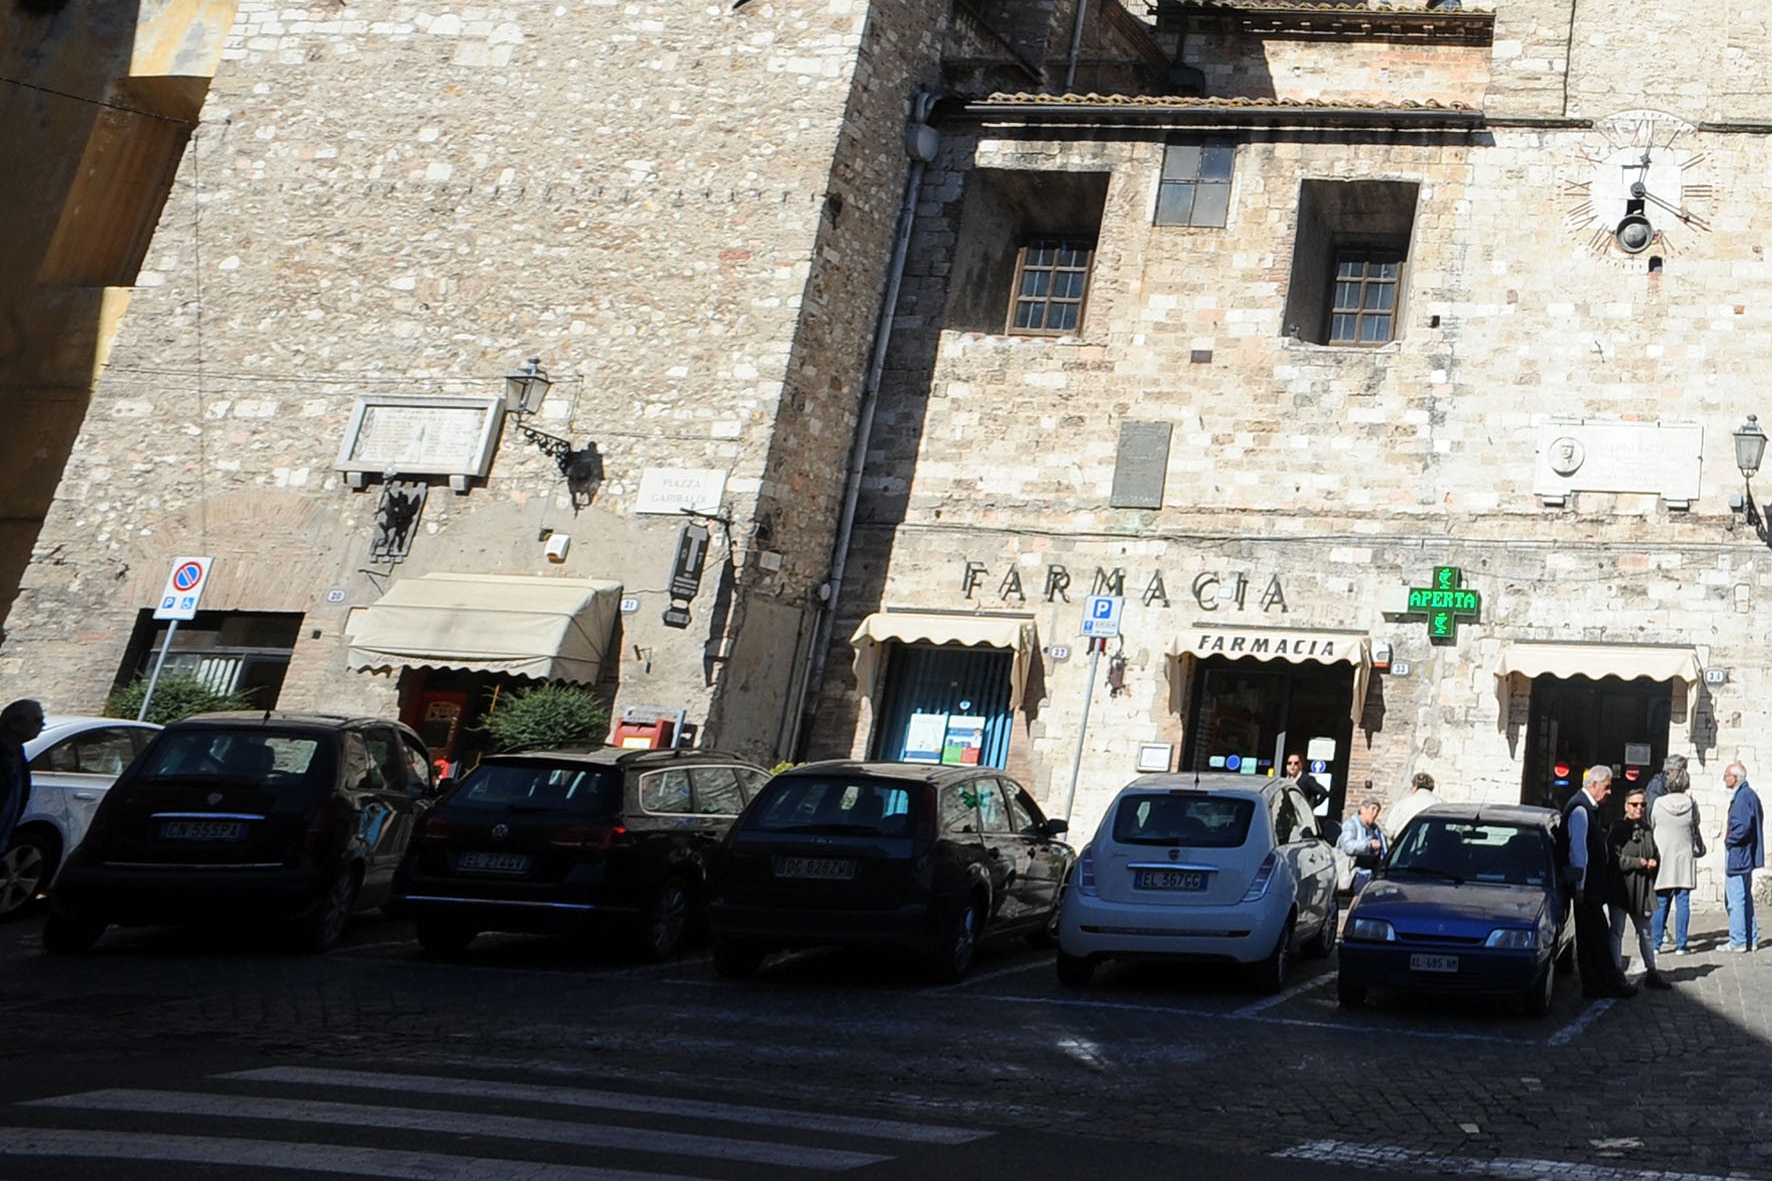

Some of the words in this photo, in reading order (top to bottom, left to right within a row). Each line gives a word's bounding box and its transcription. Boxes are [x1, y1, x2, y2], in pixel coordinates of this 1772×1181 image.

[663, 479, 701, 488] PIAZZA
[650, 493, 706, 503] GARIBALDI
[685, 525, 708, 572] T
[962, 561, 1288, 614] FARMACIA
[1409, 590, 1475, 609] APERTA
[1197, 634, 1334, 656] FARMACIA
[1143, 872, 1158, 886] EL
